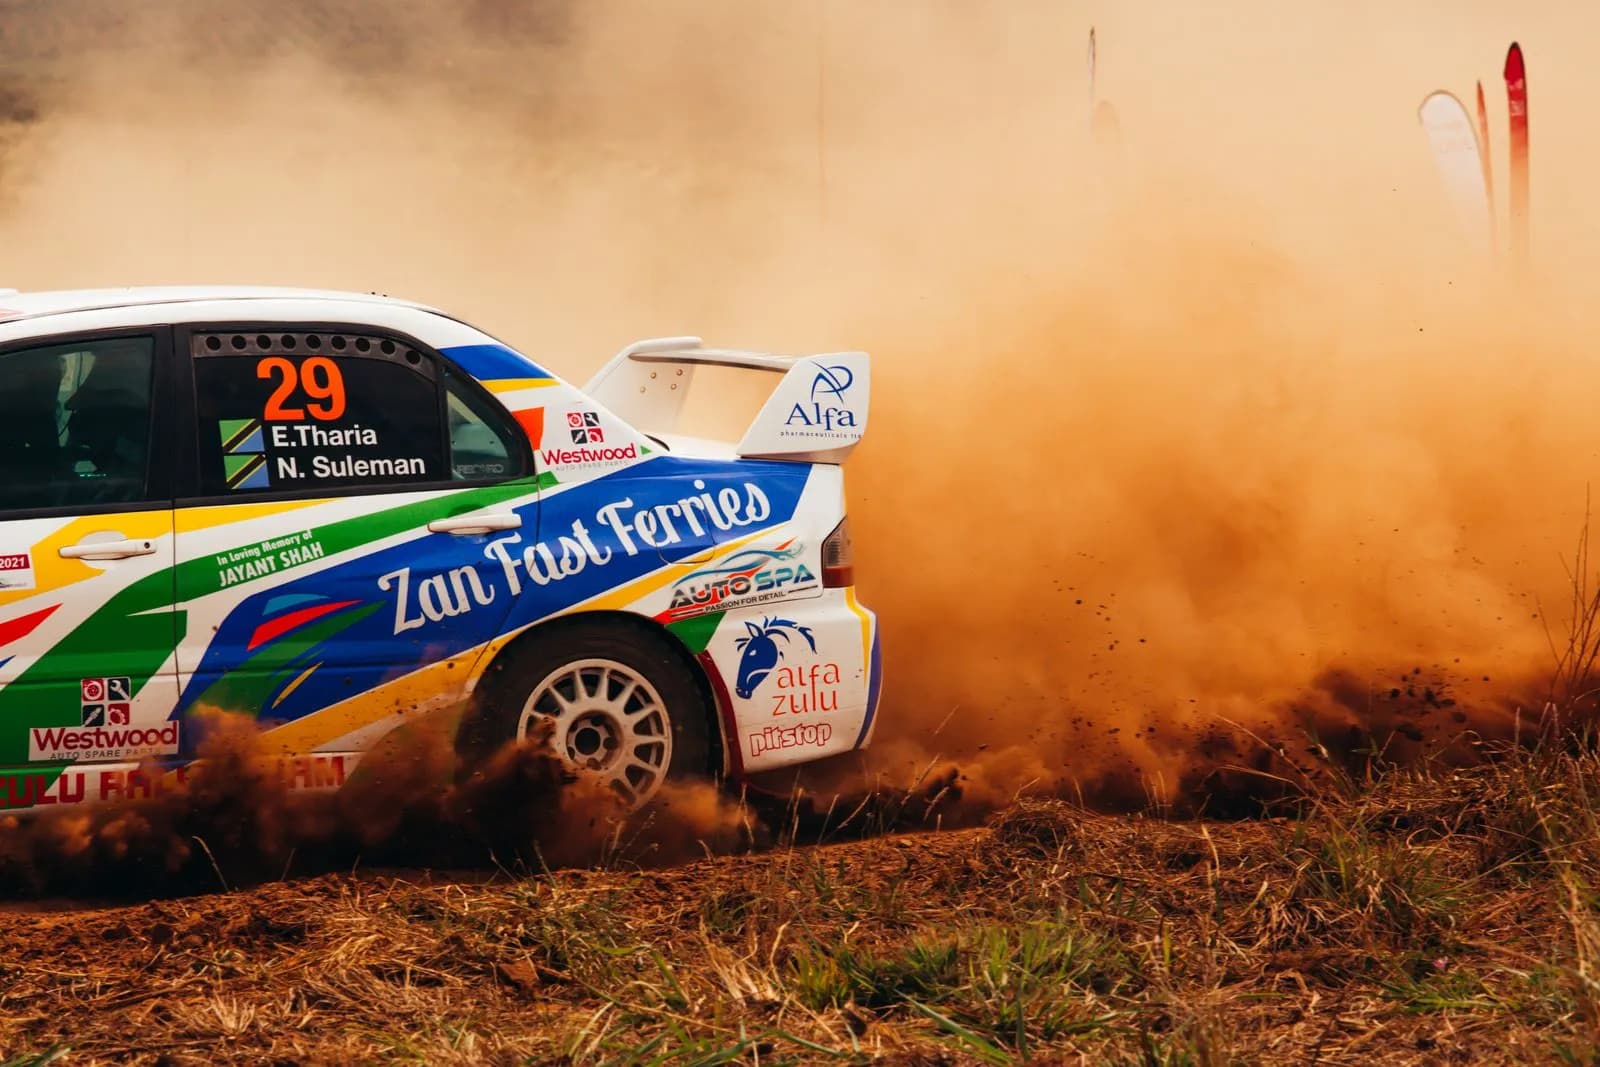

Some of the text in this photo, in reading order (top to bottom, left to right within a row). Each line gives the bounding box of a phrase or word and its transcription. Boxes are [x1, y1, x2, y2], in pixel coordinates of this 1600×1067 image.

[256, 356, 347, 422] 29
[784, 401, 858, 431] Alfa
[271, 424, 379, 448] E.Tharia
[780, 430, 847, 439] pharmaceuticals
[276, 454, 427, 479] N. Suleman
[541, 443, 637, 466] Westwood
[555, 463, 576, 472] AUTO
[216, 528, 313, 566] In Loving Memory of
[377, 479, 772, 636] Zan Fast Ferries
[0, 556, 25, 569] 2021
[219, 541, 325, 588] JAYANT SHAH
[705, 592, 787, 613] PASSION FOR DETAIL
[777, 663, 841, 689] alfa
[772, 689, 838, 716] zulu
[34, 721, 178, 751] Westwood
[749, 722, 832, 757] pitstop
[50, 751, 80, 761] AUTO
[84, 749, 121, 760] SPARE
[0, 772, 86, 808] ULU
